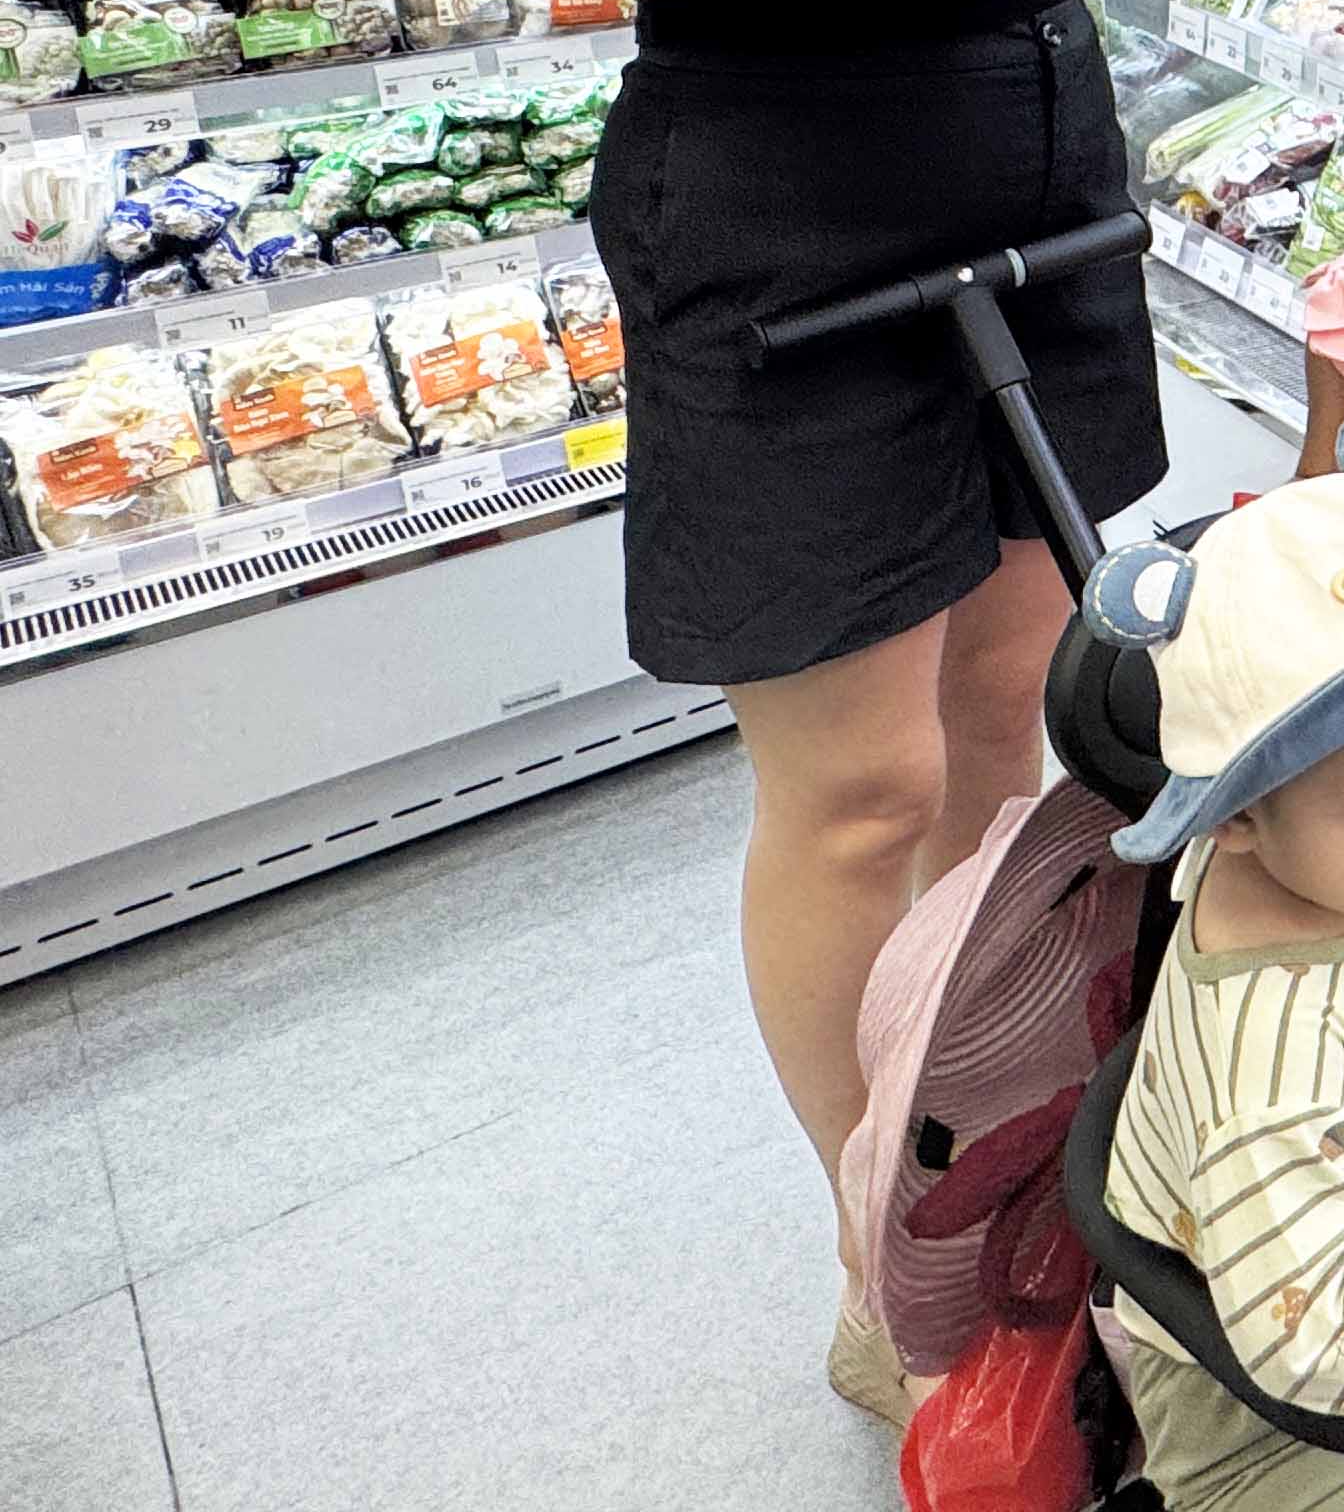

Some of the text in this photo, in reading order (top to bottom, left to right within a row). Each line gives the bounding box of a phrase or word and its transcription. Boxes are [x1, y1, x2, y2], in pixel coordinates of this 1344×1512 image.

[550, 60, 574, 74] 34
[432, 77, 458, 92] 64
[144, 118, 172, 134] 29
[497, 261, 519, 275] 14
[228, 317, 246, 330] 11
[461, 476, 482, 490] 16
[263, 526, 285, 542] 19
[68, 574, 95, 591] 35
